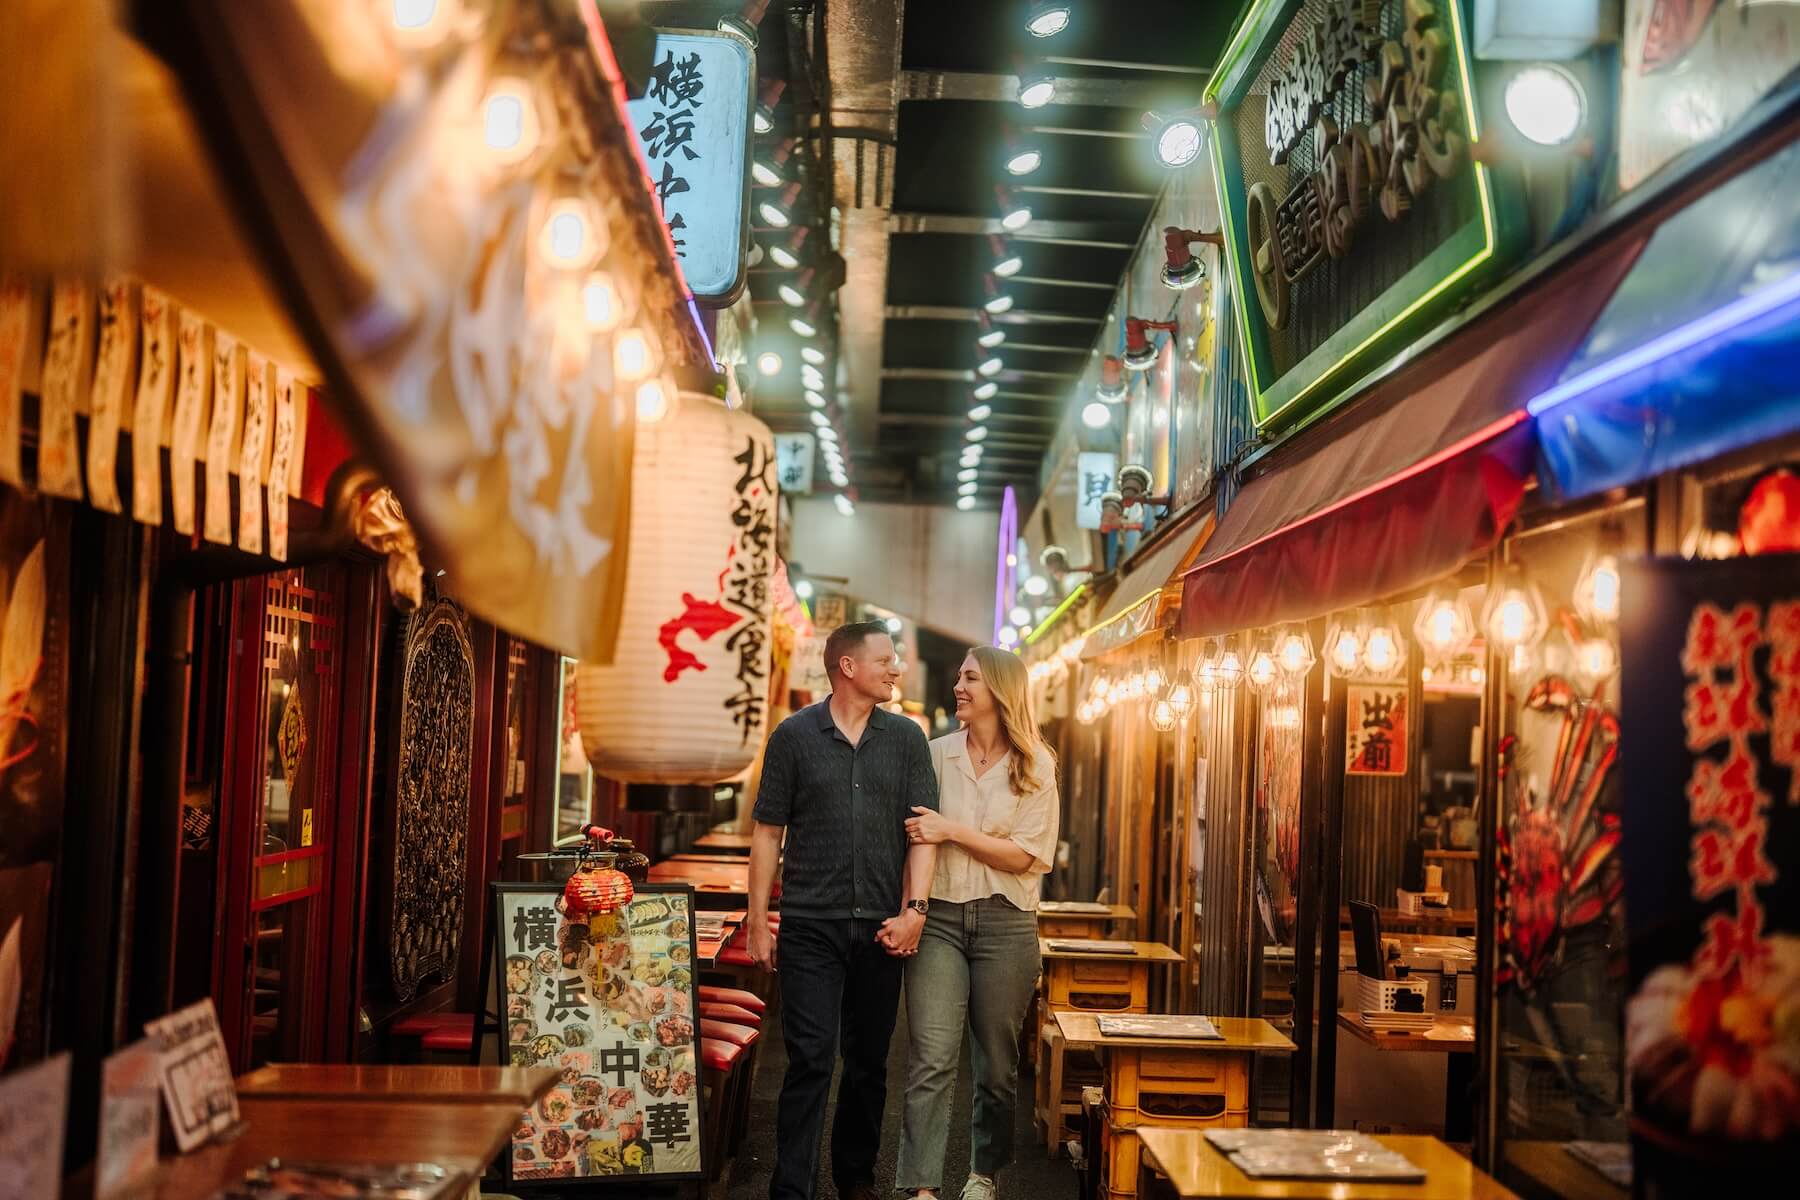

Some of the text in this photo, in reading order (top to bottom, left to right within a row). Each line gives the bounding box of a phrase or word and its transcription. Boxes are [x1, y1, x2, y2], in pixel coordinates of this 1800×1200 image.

[1361, 692, 1393, 770] 出前
[513, 907, 691, 1149] 横浜中華
